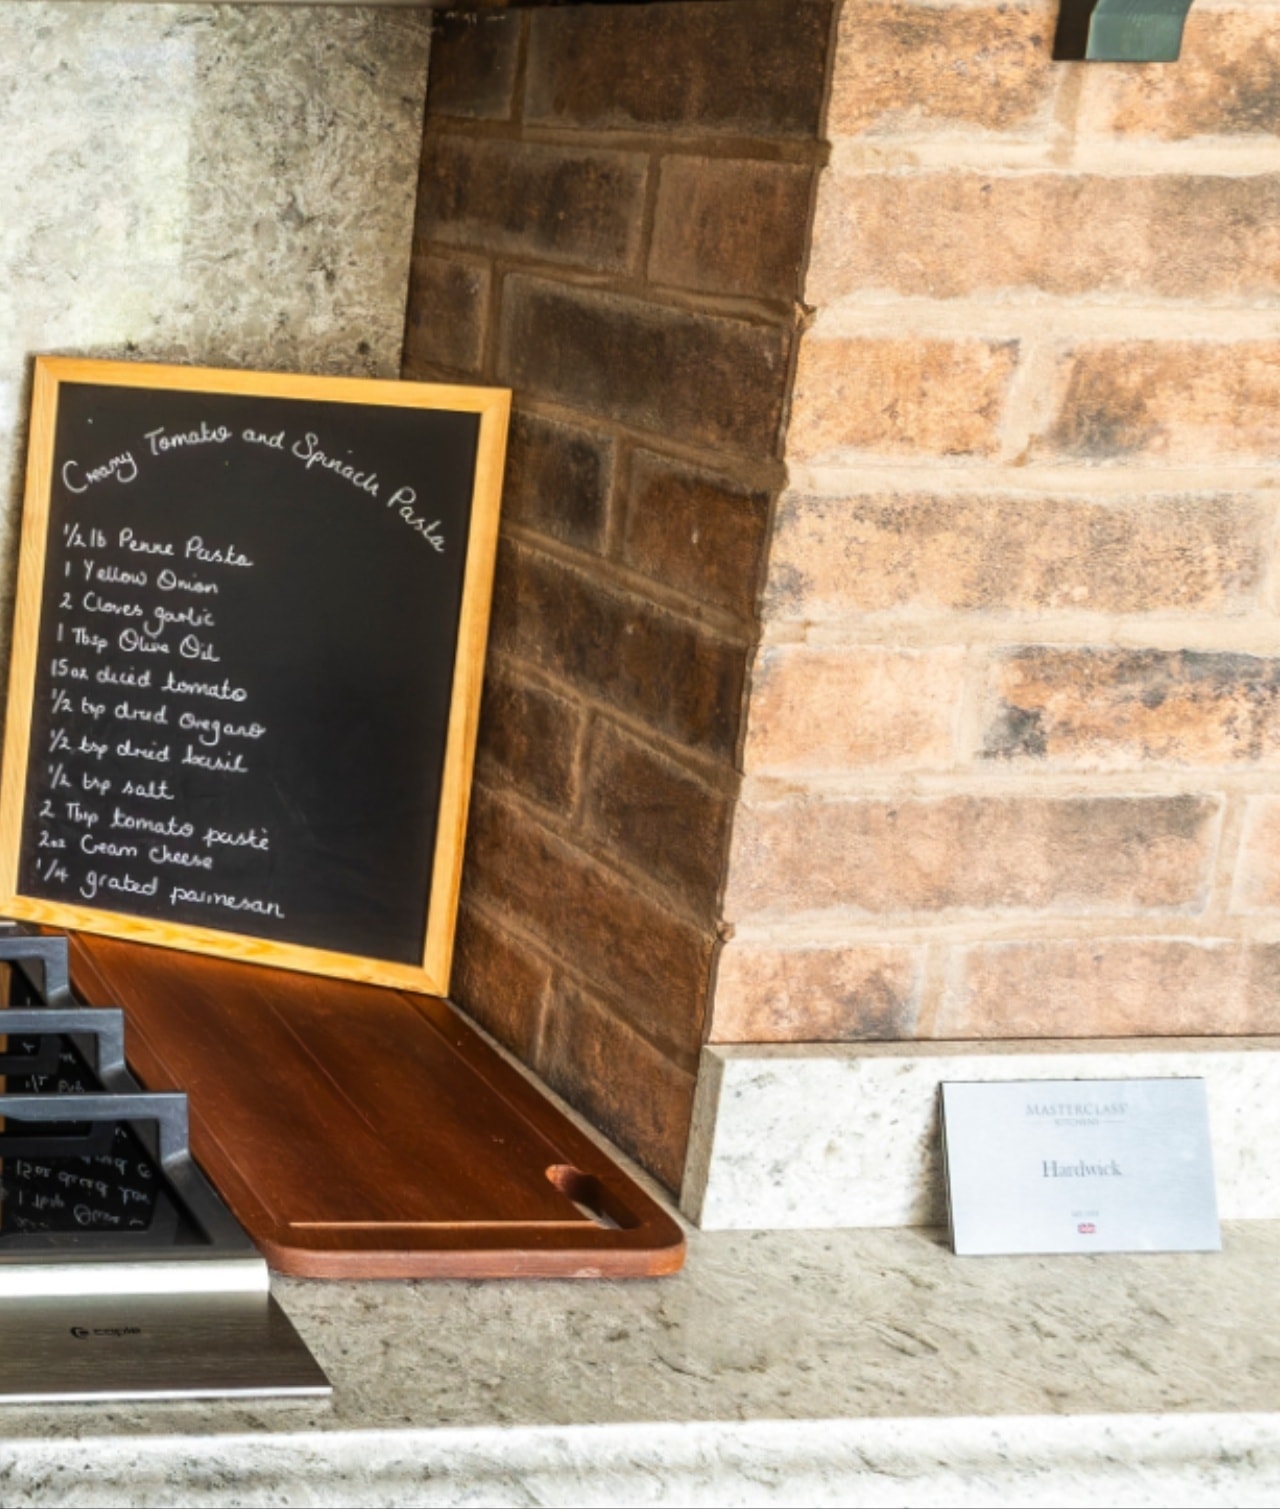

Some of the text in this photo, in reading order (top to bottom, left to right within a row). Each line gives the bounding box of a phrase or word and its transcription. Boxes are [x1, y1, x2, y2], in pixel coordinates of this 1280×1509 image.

[62, 421, 445, 553] Creamy Tomato and Spinach Pasta
[119, 527, 175, 556] Penne
[185, 535, 254, 567] Pasta
[84, 558, 147, 585] Yellow
[157, 568, 219, 594] Onion
[59, 592, 215, 637] 2 Cloves garlic
[72, 627, 108, 654] Tbsp
[119, 628, 170, 653] Olive
[179, 633, 220, 662] Oil
[96, 666, 152, 687] diced
[161, 670, 248, 702] tomato
[114, 701, 168, 725] dried
[78, 735, 108, 760] tsp
[117, 738, 170, 762] dried
[182, 744, 248, 773] basil
[121, 779, 175, 801] salt
[39, 800, 55, 818] 2
[109, 807, 195, 836] tomato
[80, 834, 138, 857] Cream
[79, 870, 158, 898] grated
[1042, 1160, 1123, 1177] Hardwick
